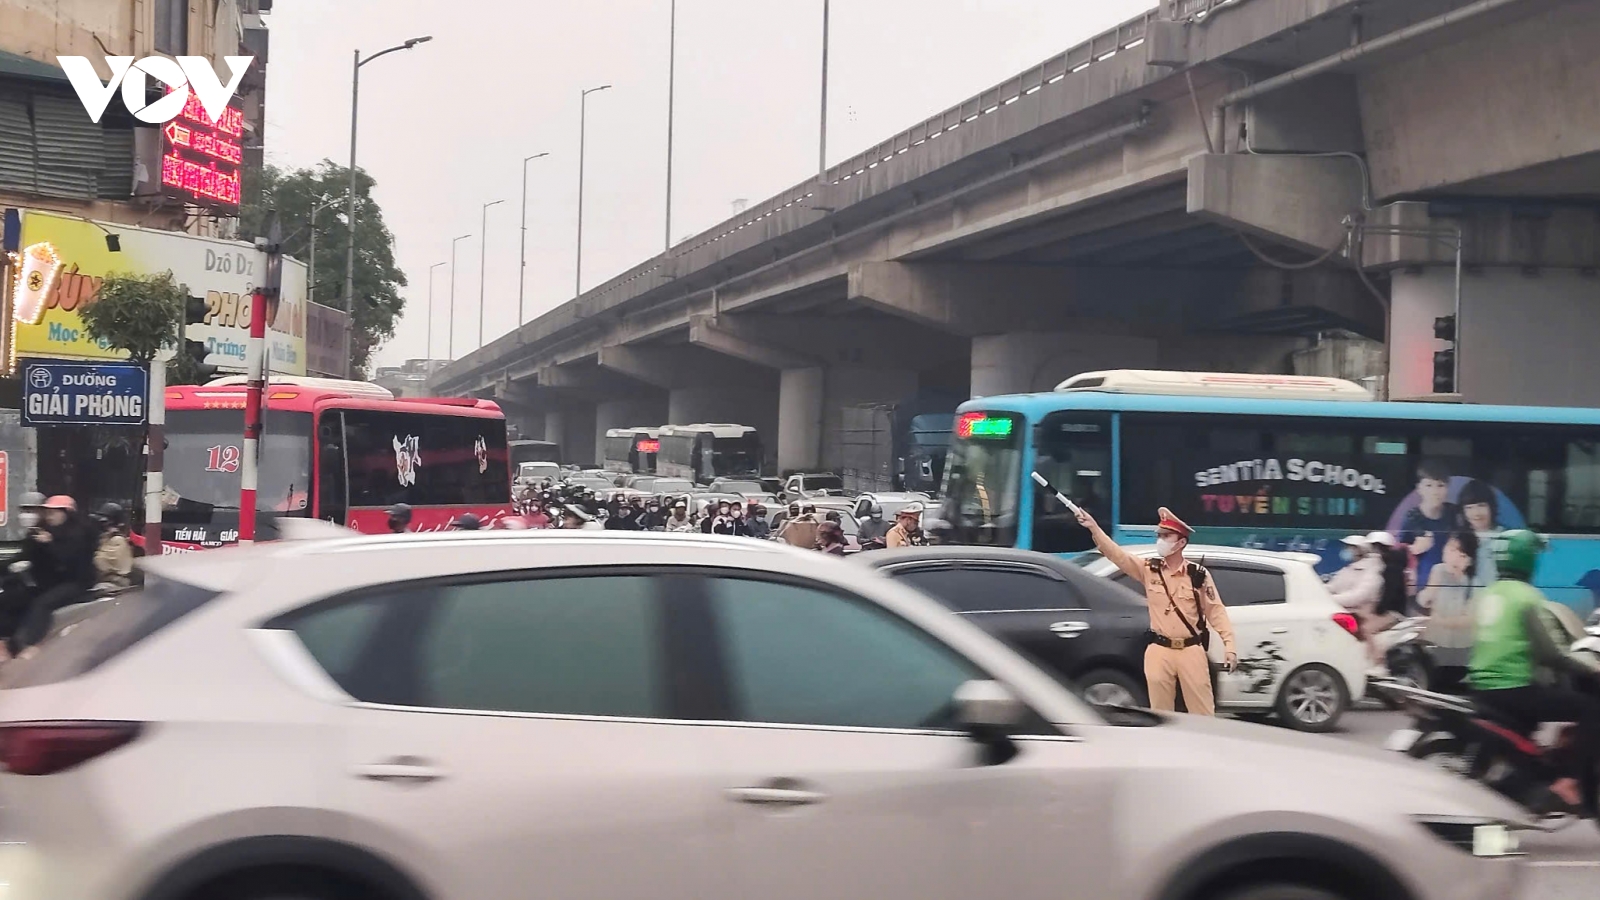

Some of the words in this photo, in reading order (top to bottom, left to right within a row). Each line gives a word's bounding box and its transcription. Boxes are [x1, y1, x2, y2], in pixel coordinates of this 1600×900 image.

[205, 249, 231, 273] Dzô
[236, 253, 253, 276] Dz
[48, 321, 78, 346] Mọc
[207, 336, 247, 361] Trứng
[29, 386, 69, 417] GIẢI
[75, 390, 142, 418] PHÓNG
[205, 445, 240, 473] 12
[1286, 458, 1386, 495] SCHOOL
